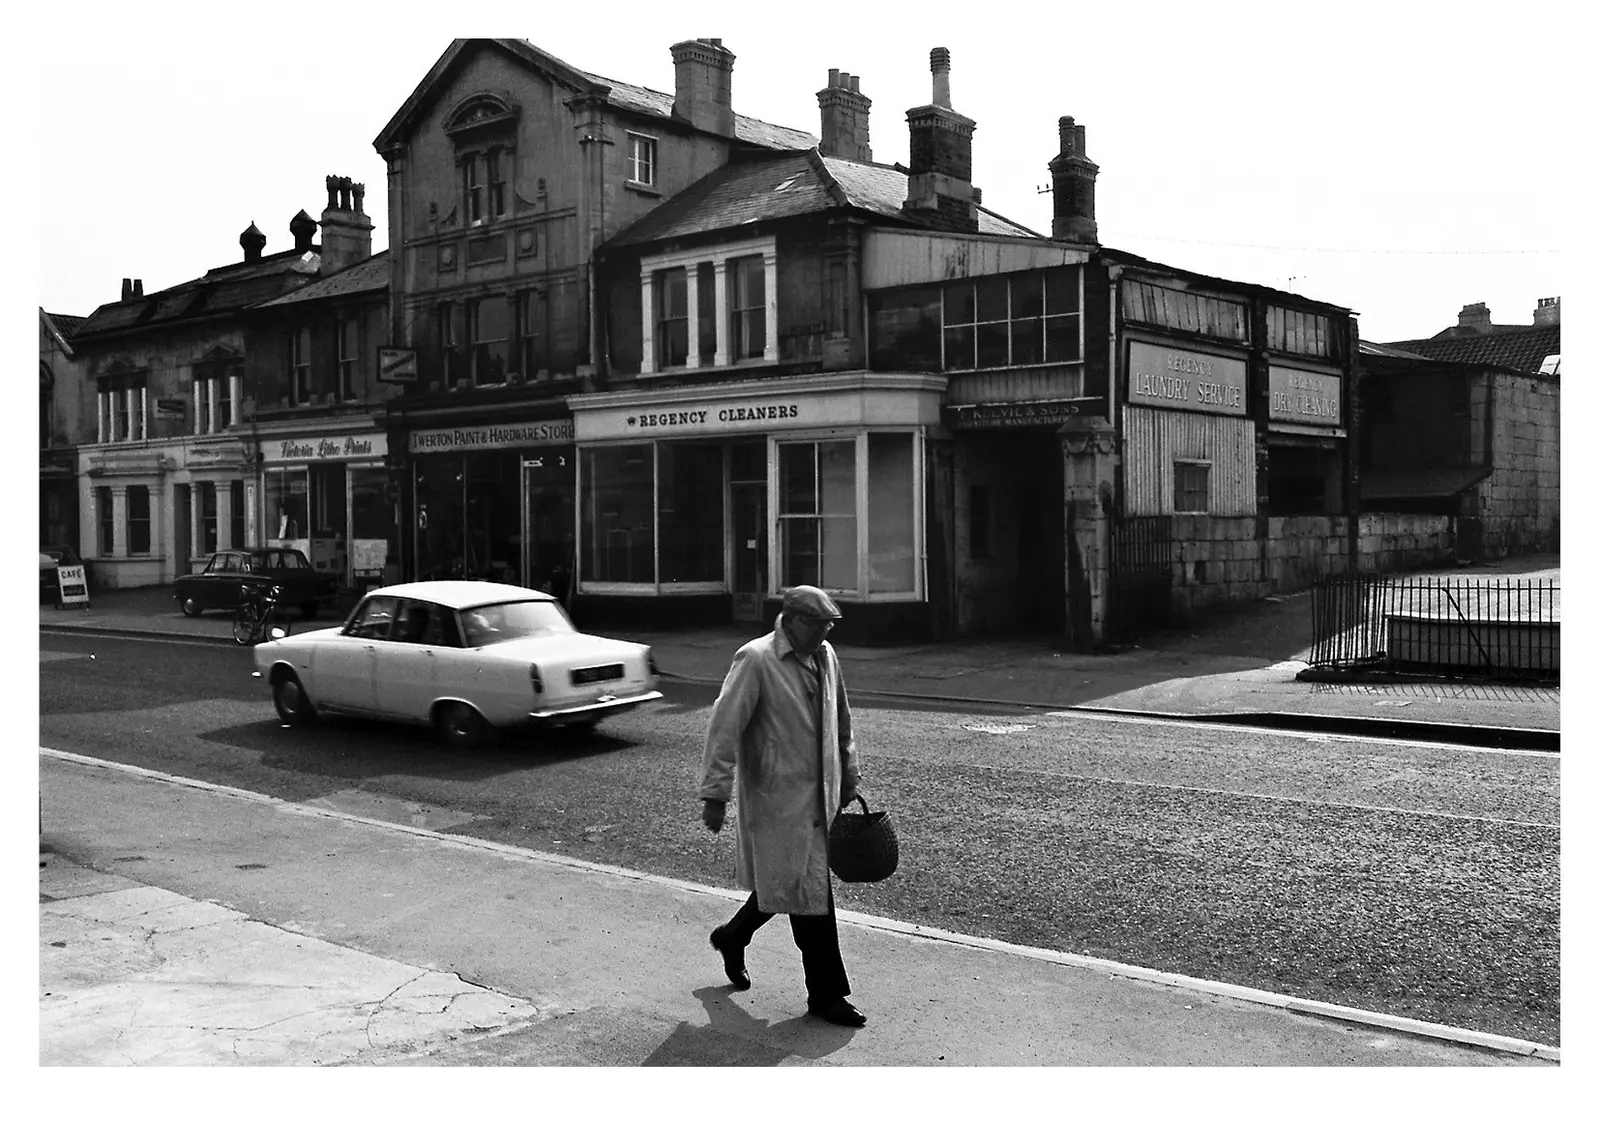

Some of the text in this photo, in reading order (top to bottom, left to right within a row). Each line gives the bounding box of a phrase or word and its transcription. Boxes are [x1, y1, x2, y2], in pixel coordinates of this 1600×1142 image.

[1167, 355, 1214, 376] REGENCY
[1135, 372, 1241, 408] LAUNDRY SERVICE
[1288, 374, 1323, 393] REGENCY
[1039, 403, 1080, 415] SONS
[1273, 391, 1337, 419] DRY CLEANING
[639, 405, 797, 427] REGENCY CLEANERS
[413, 433, 453, 448] TWERTON
[454, 430, 480, 445] PAINT
[481, 431, 488, 442] &
[489, 425, 539, 443] HARDWARE
[281, 437, 372, 458] Victoria Litho Prints
